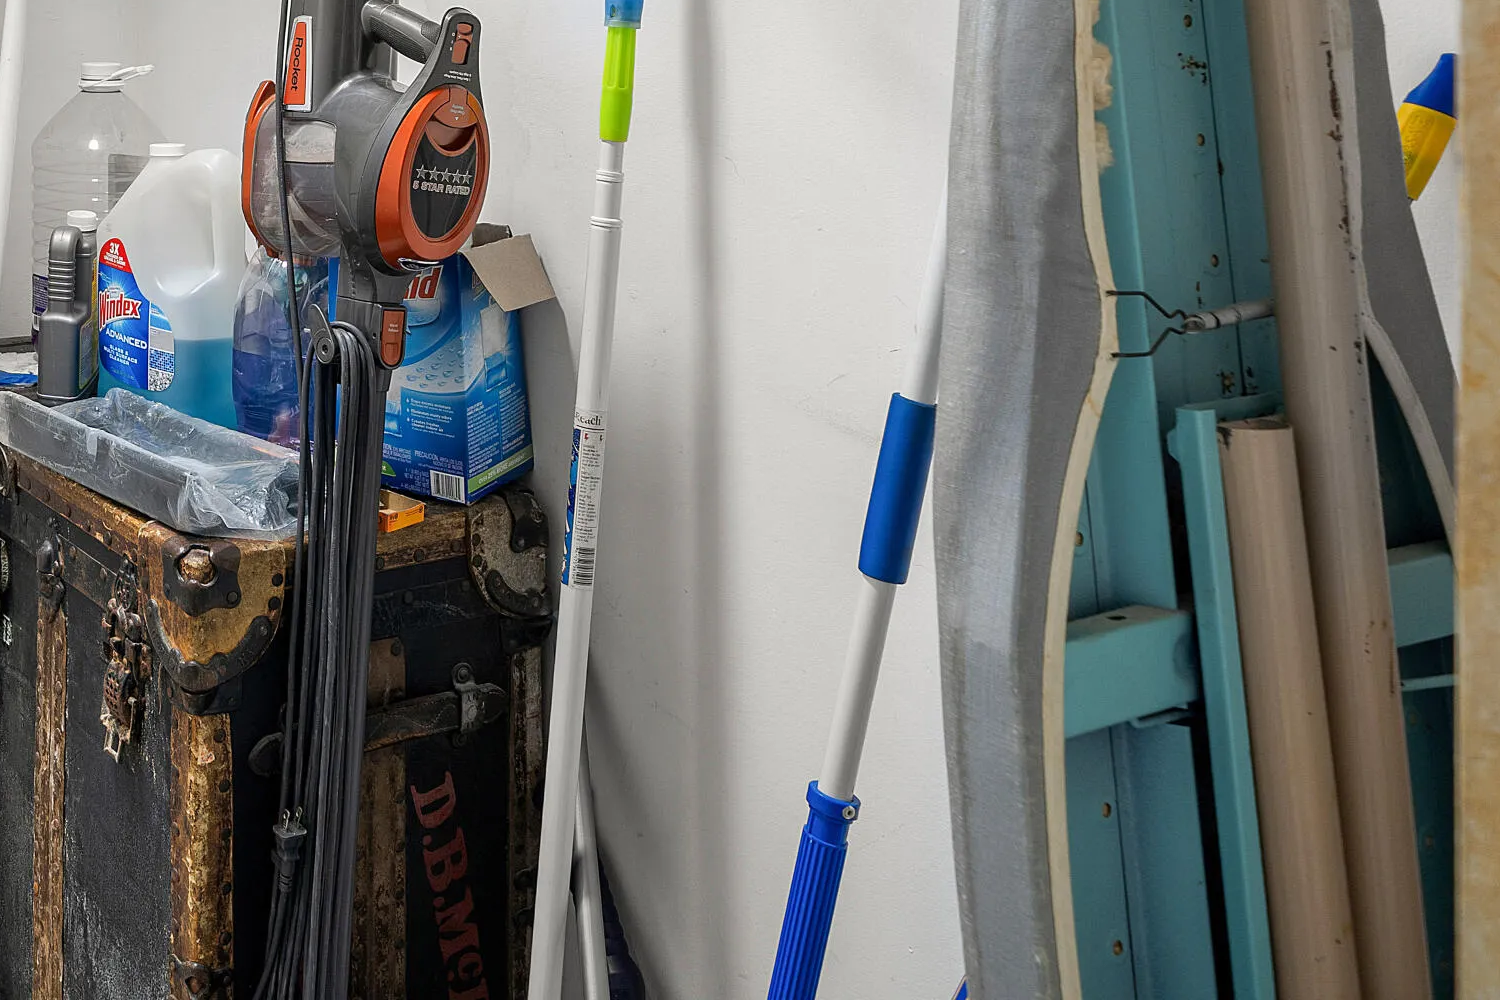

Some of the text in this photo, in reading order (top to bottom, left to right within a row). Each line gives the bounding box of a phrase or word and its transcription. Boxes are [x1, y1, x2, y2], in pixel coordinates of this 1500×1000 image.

[290, 37, 303, 91] Rocket
[421, 181, 444, 193] STAR
[445, 184, 471, 195] RATED
[109, 242, 120, 256] 3X
[99, 290, 142, 330] Windex
[105, 328, 148, 350] ADVANCED
